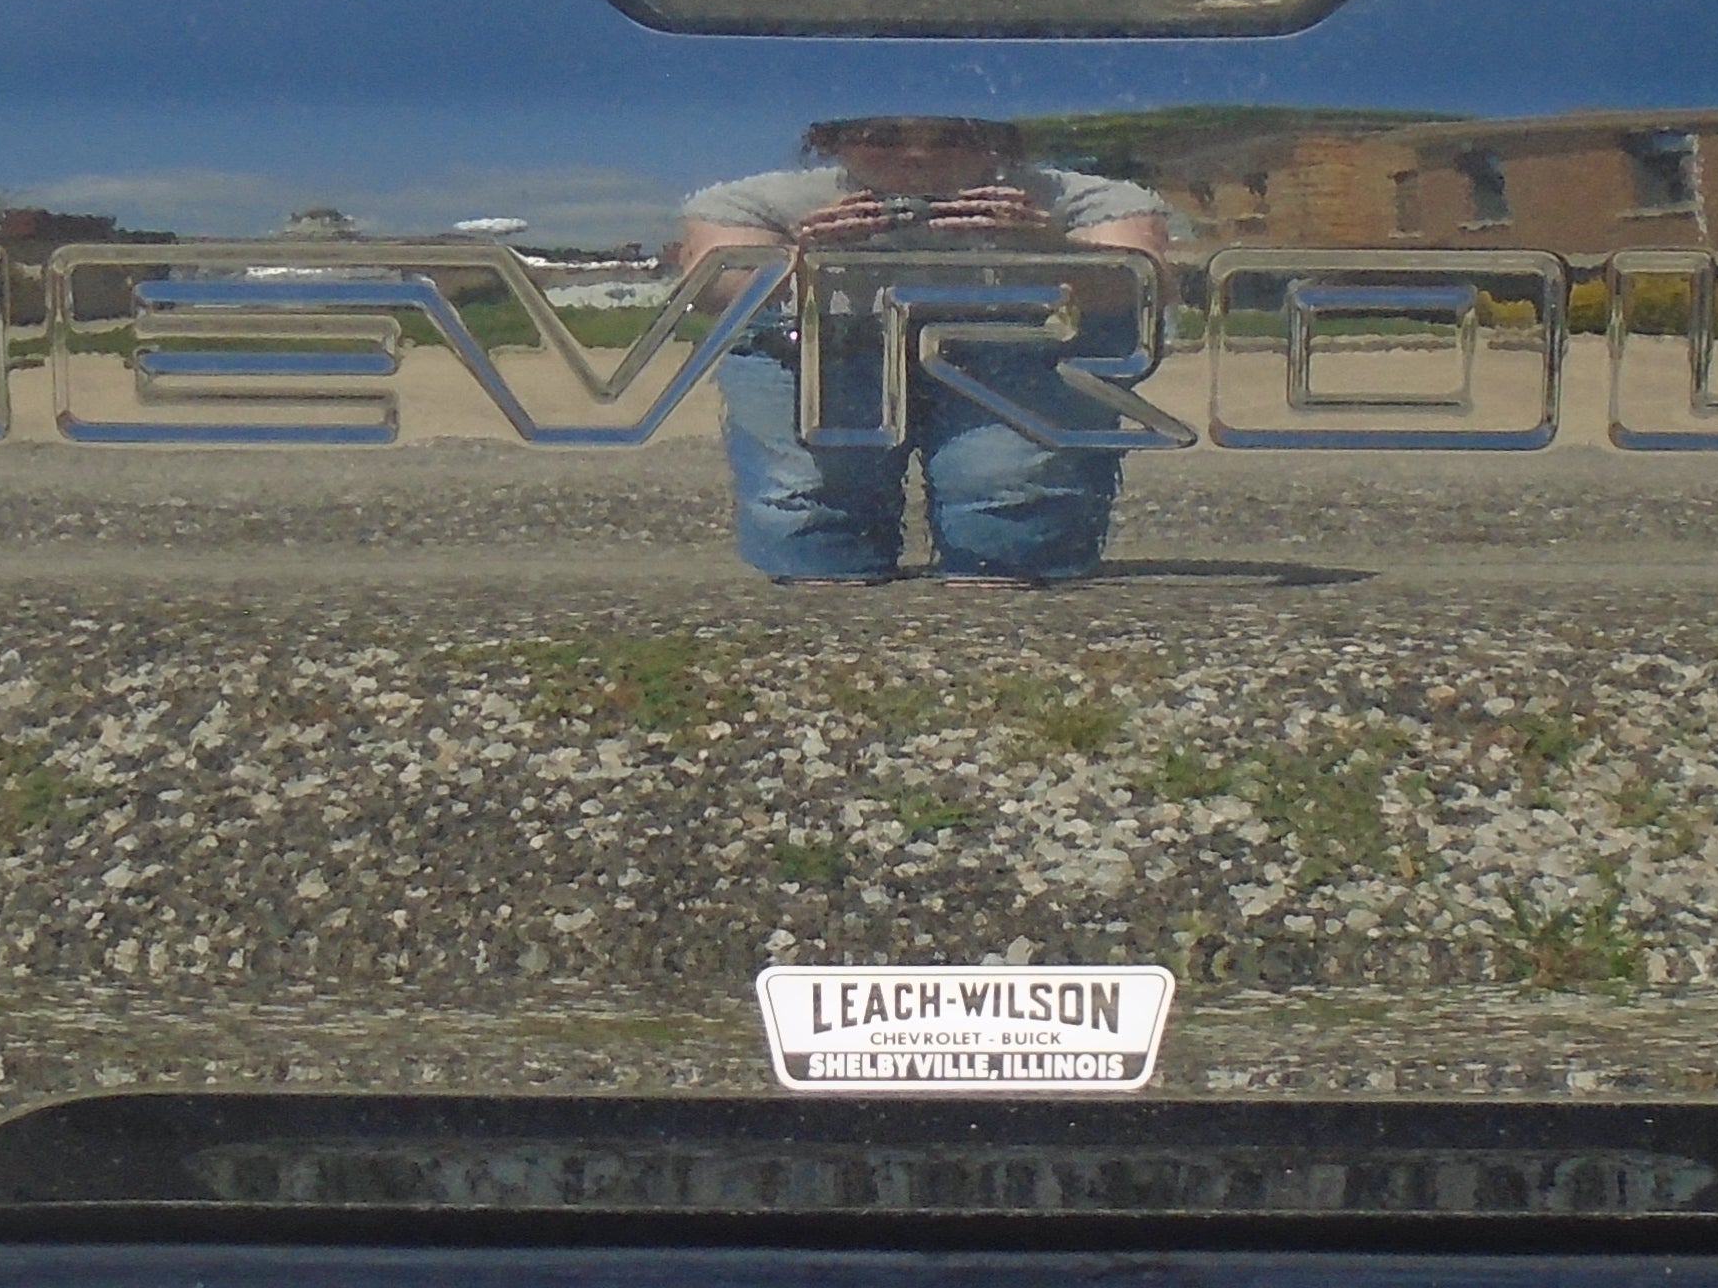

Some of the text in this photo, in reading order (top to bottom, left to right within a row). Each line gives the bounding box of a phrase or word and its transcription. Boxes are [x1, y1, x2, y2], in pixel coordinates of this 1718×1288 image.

[812, 982, 1121, 1035] LEACH-WILSON
[870, 1031, 982, 1046] CHEVROLET
[1001, 1031, 1062, 1045] BUICK
[808, 1052, 1125, 1080] SHELBYVILLE, ILLINOIS
